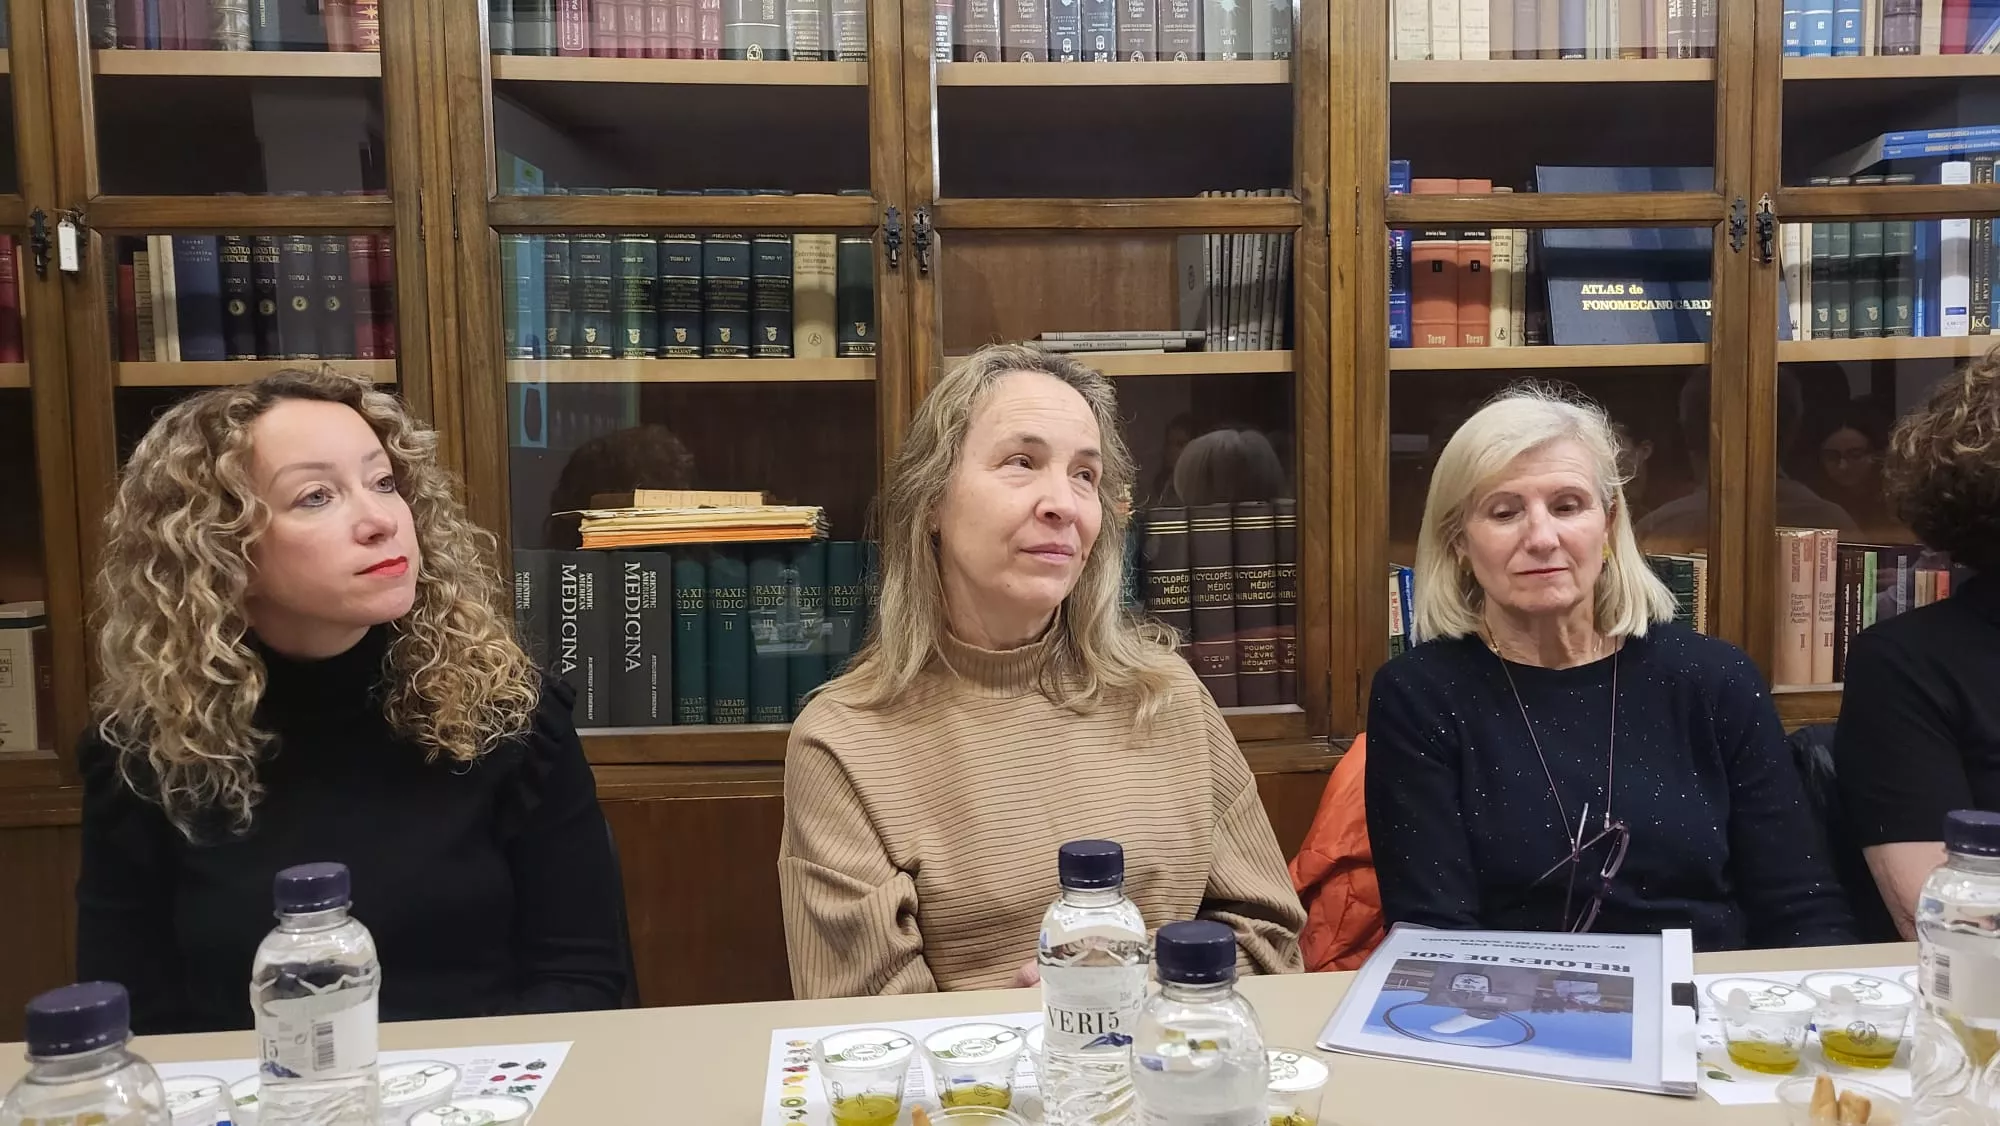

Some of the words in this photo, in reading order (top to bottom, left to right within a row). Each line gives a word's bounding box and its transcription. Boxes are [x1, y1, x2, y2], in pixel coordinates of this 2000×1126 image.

[1581, 284, 1625, 295] ATLAS
[1582, 299, 1712, 311] FONOMECANOCARD
[1427, 334, 1446, 345] Toray
[1465, 334, 1484, 345] Toray
[522, 571, 530, 609] SCIENTIFIC
[642, 570, 650, 609] AMERICAN
[649, 570, 657, 609] SCIENTIFIC
[1207, 582, 1232, 591] MÉDIC
[1250, 581, 1275, 590] MÉDIC
[578, 573, 586, 610] AMERICAN
[676, 599, 704, 609] EDIC
[561, 563, 577, 674] MEDICINA
[624, 561, 642, 673] MEDICINA
[724, 620, 733, 631] II
[843, 619, 850, 628] V
[1403, 951, 1455, 959] SOL
[1463, 954, 1499, 962] DE
[1509, 957, 1631, 973] RELOJES
